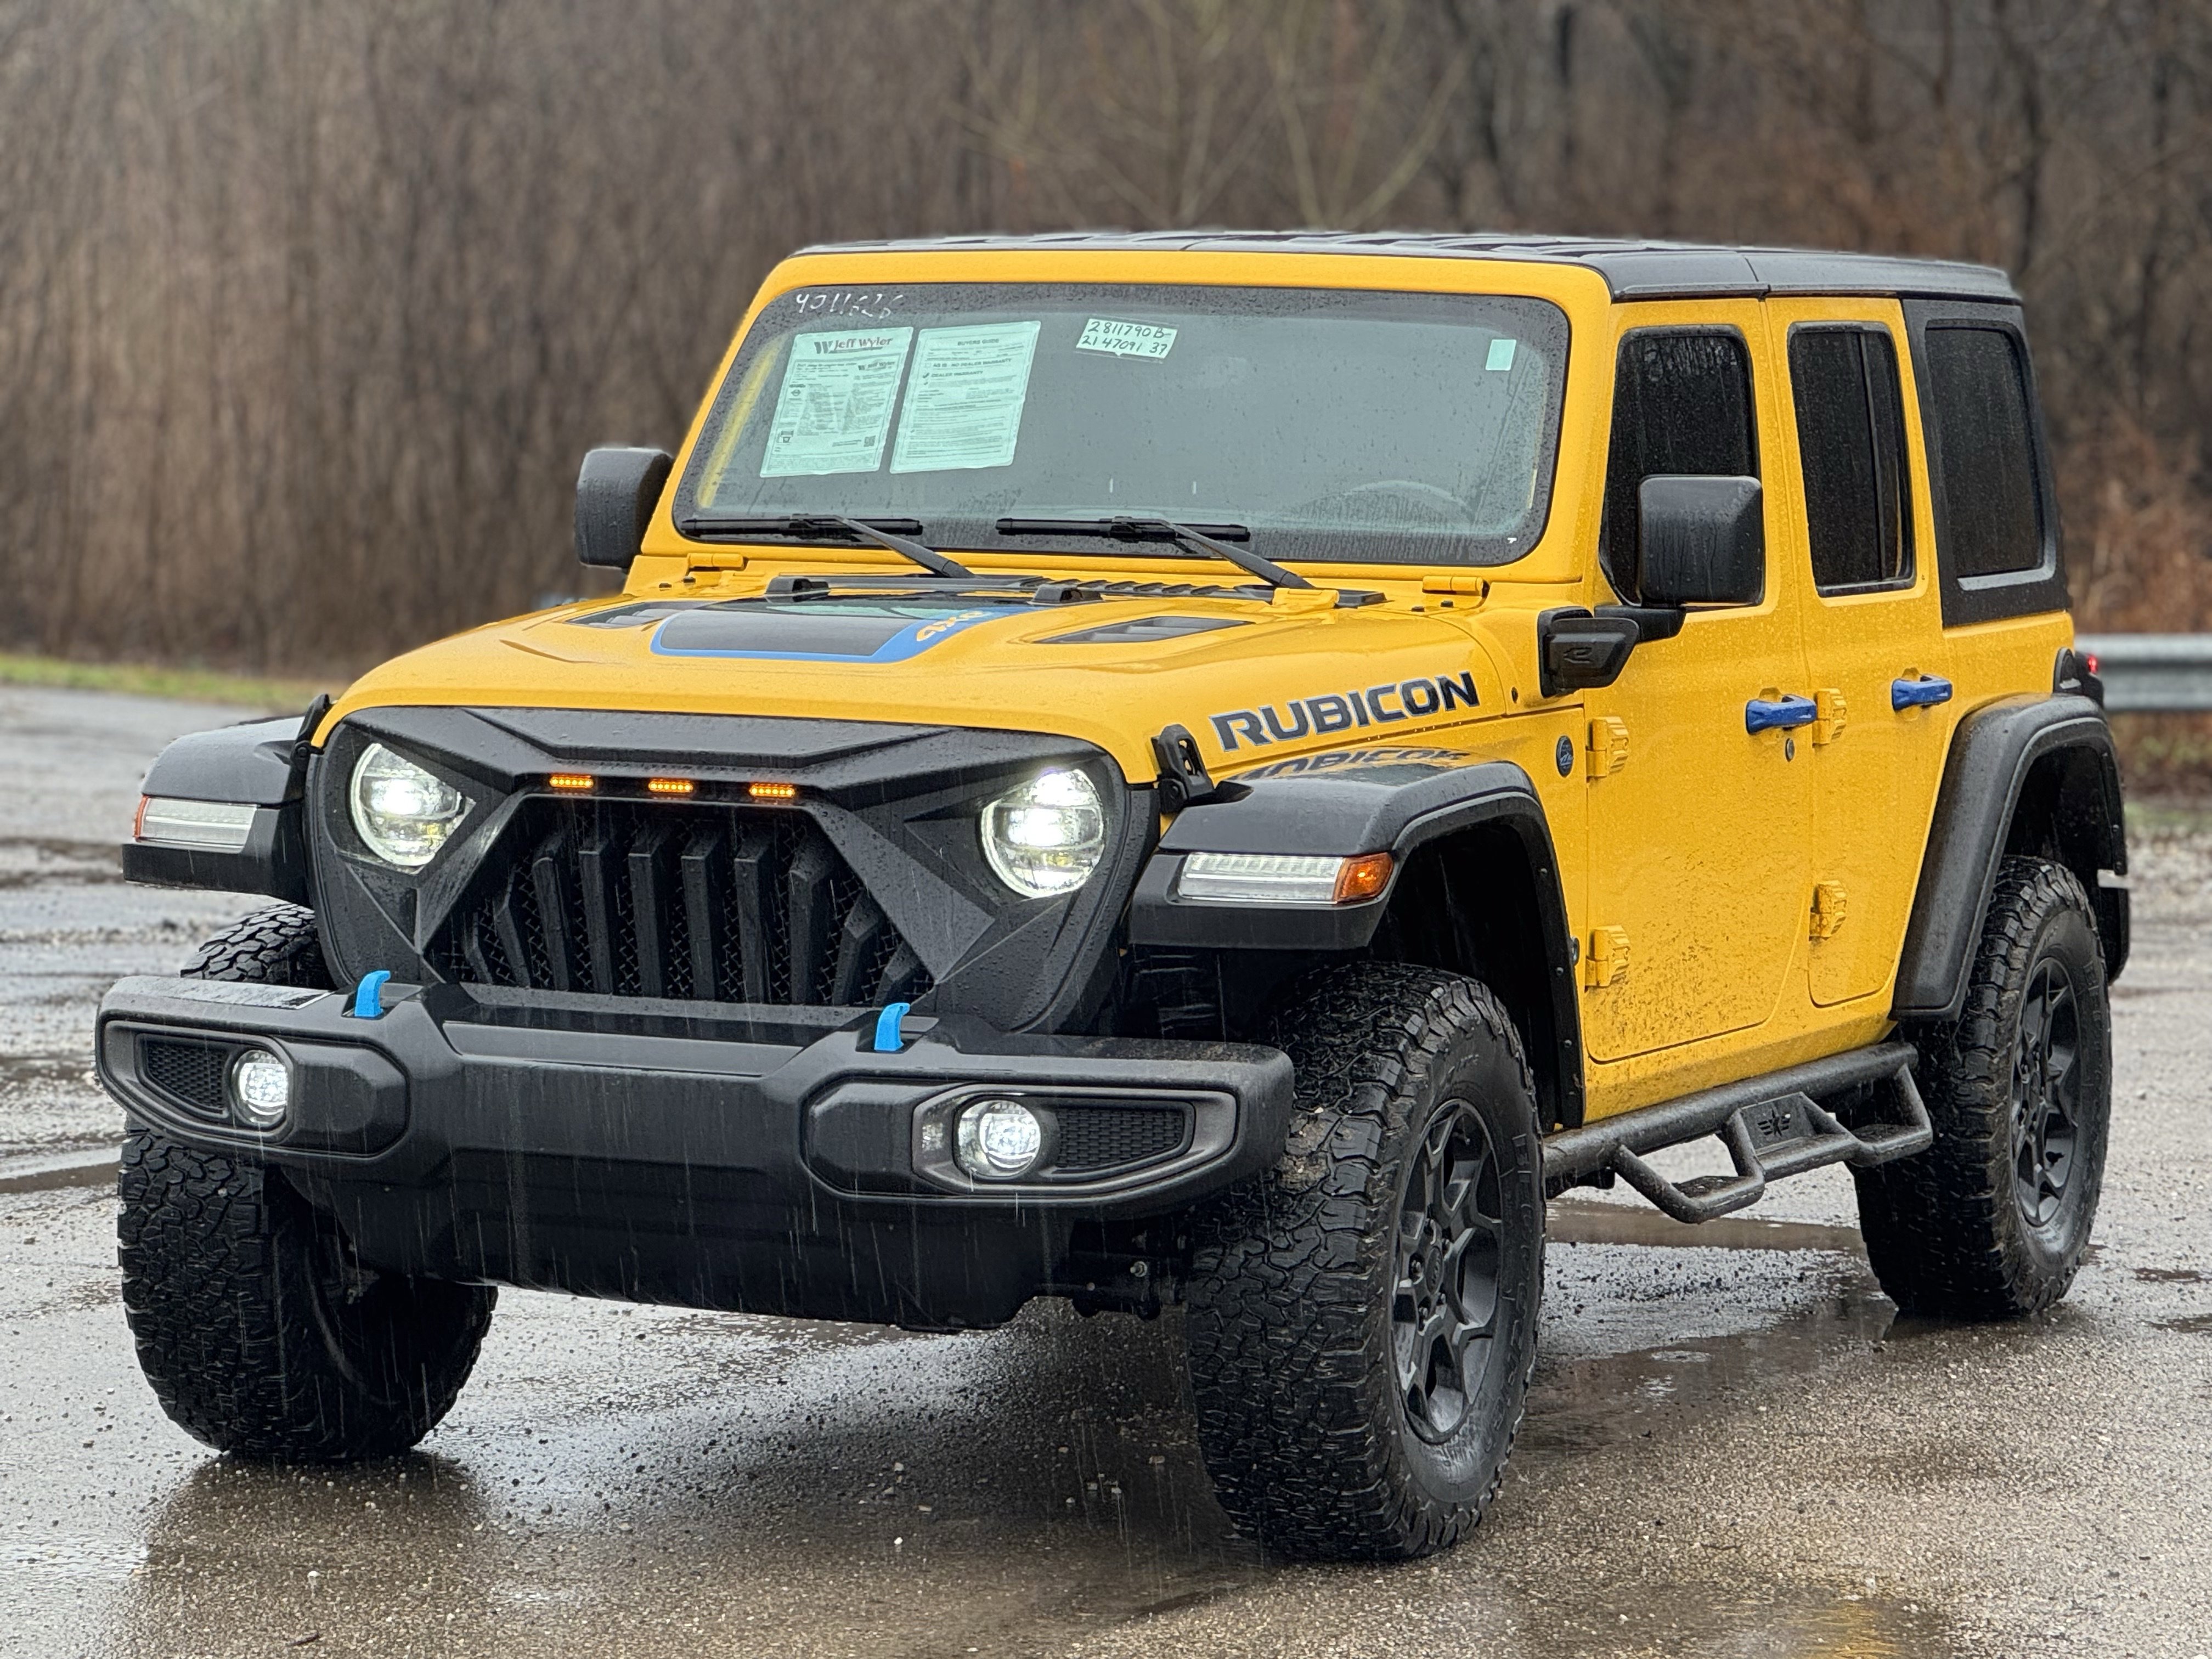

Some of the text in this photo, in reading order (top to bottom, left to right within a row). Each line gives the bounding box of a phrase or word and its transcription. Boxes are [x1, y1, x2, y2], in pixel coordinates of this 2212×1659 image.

[833, 338, 857, 351] Jeff
[859, 337, 894, 348] Wyler
[1207, 670, 1480, 752] RUBICON
